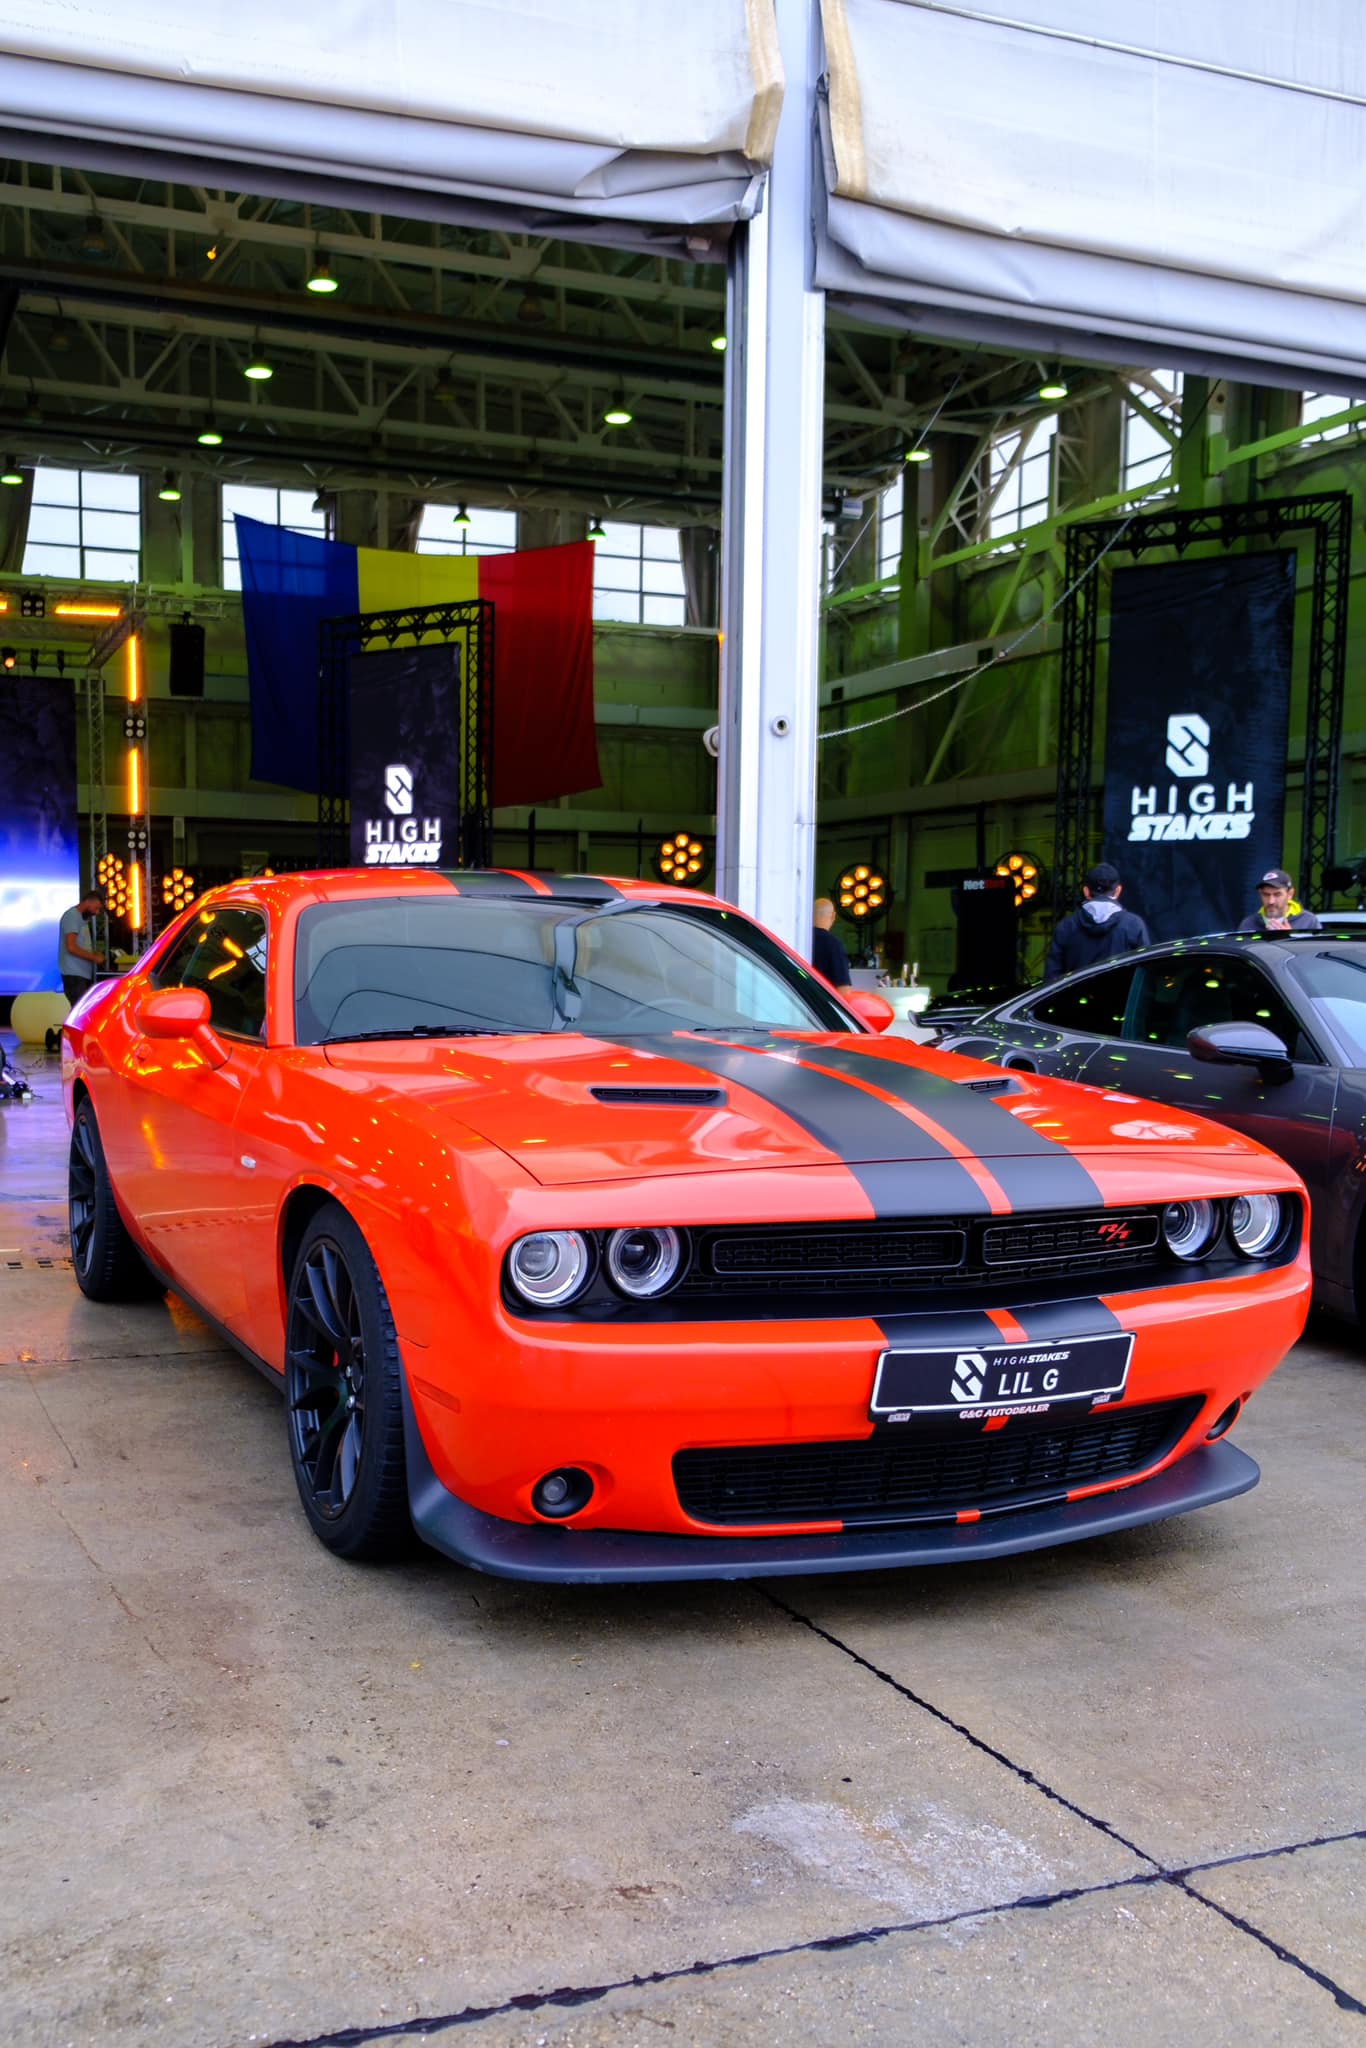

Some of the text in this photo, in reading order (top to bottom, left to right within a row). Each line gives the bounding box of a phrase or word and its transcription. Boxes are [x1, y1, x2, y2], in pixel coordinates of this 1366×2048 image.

[1131, 781, 1254, 815] HIGH
[366, 818, 441, 843] HIGH
[1127, 812, 1255, 842] STAKES
[364, 841, 442, 864] STAKES
[963, 879, 1005, 890] Net
[998, 1368, 1060, 1396] LIL G
[985, 1403, 1050, 1418] AUTODEALER
